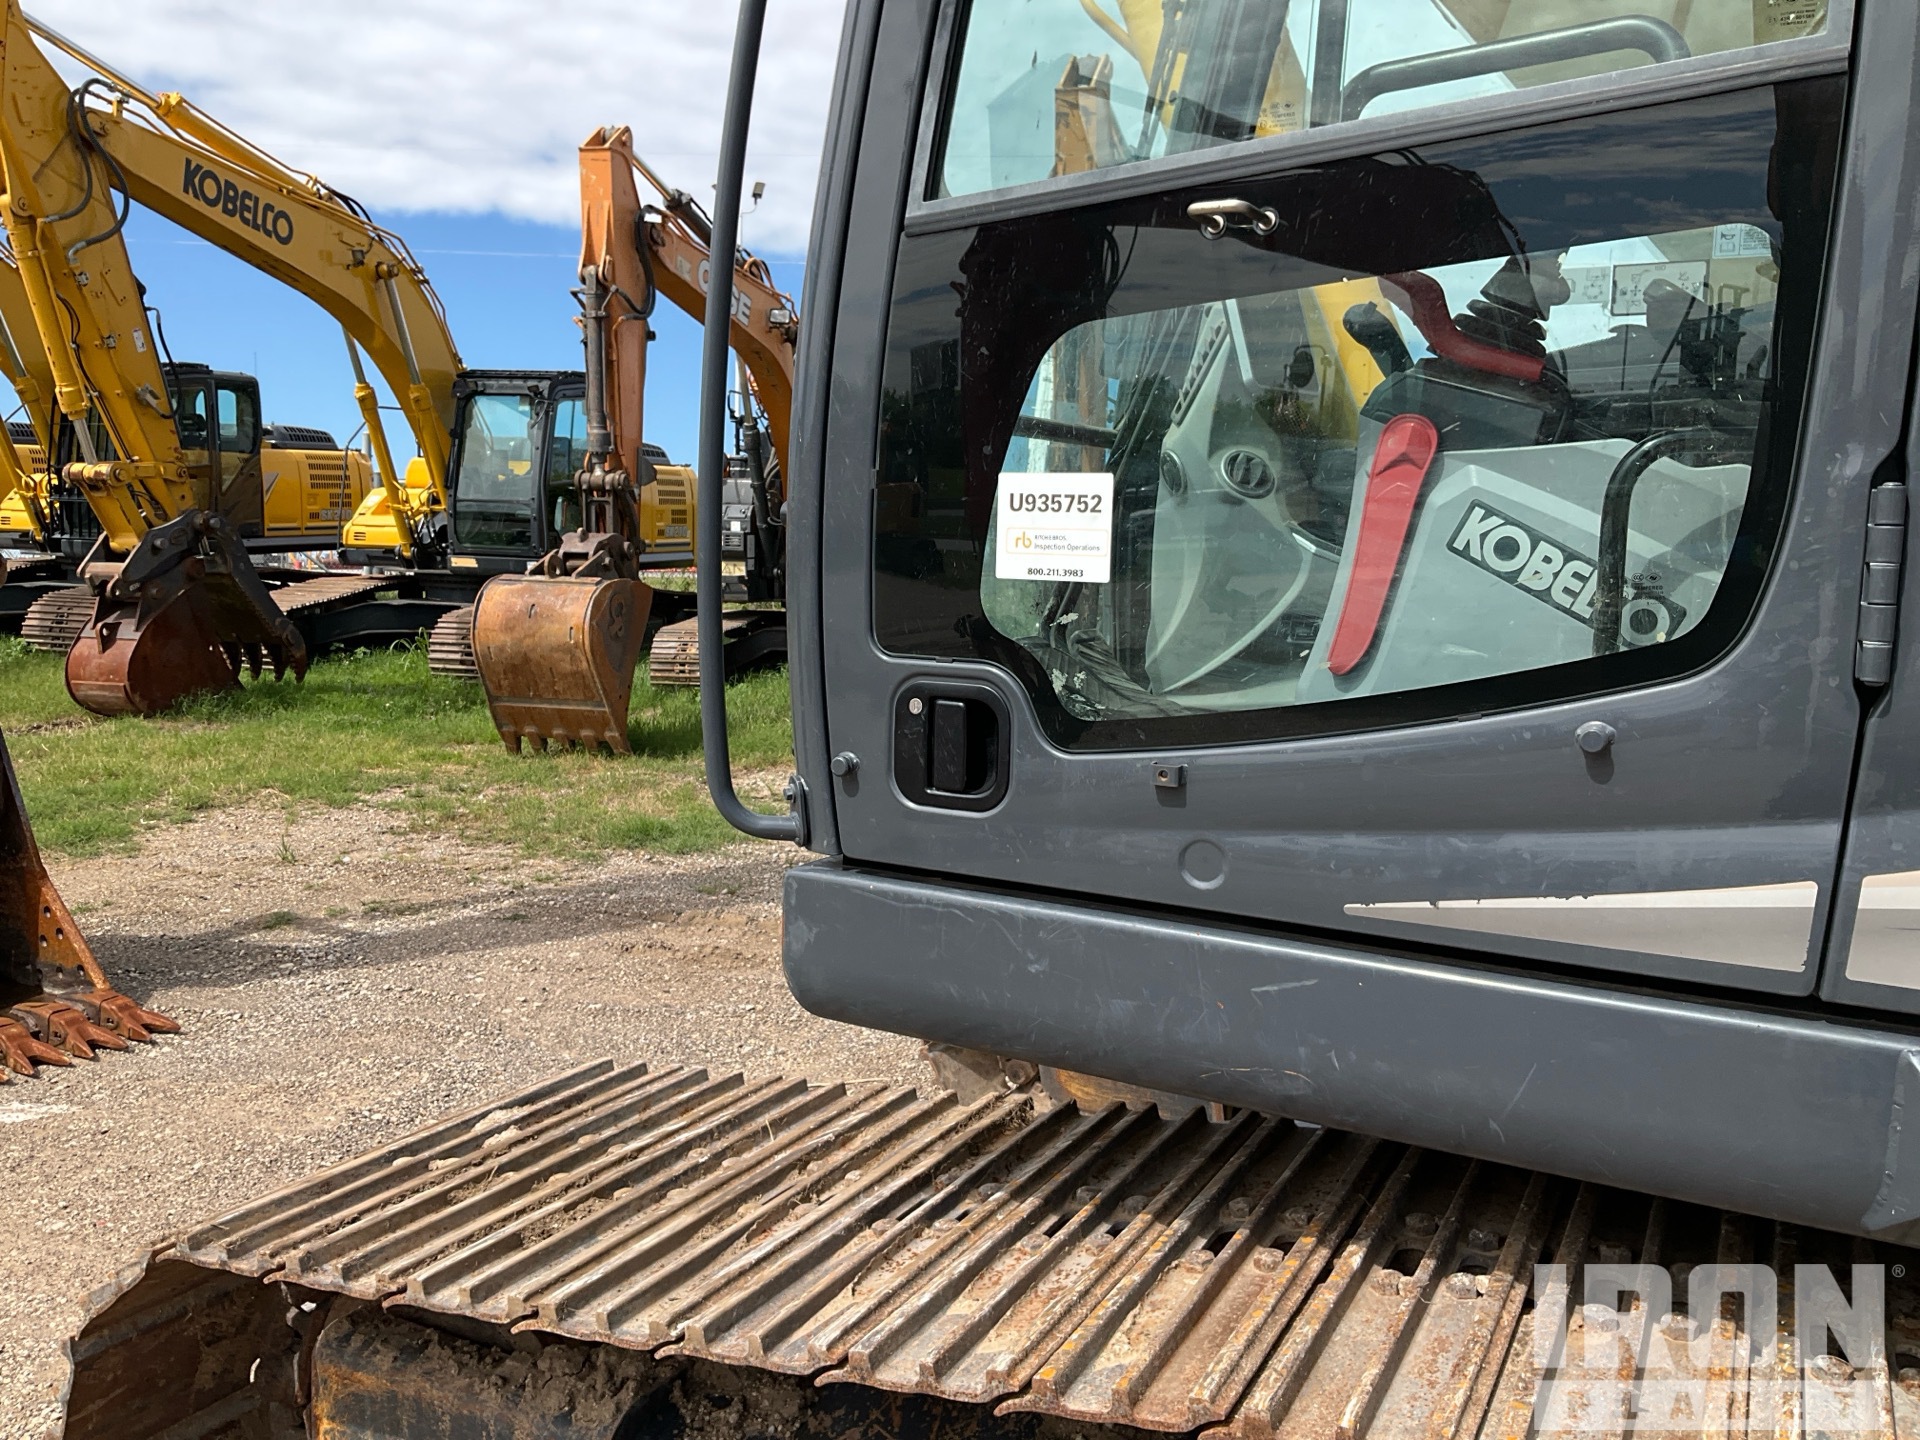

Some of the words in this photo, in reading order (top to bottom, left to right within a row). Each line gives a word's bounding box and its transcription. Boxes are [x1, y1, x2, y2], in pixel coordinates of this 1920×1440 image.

[182, 156, 294, 246] KOBELCO
[698, 259, 752, 327] CSE
[1009, 492, 1103, 514] U935752
[1034, 543, 1065, 551] Inspection
[1066, 544, 1101, 552] Operations
[1027, 568, 1084, 578] 800.211.3983
[1452, 505, 1671, 647] KOBELO
